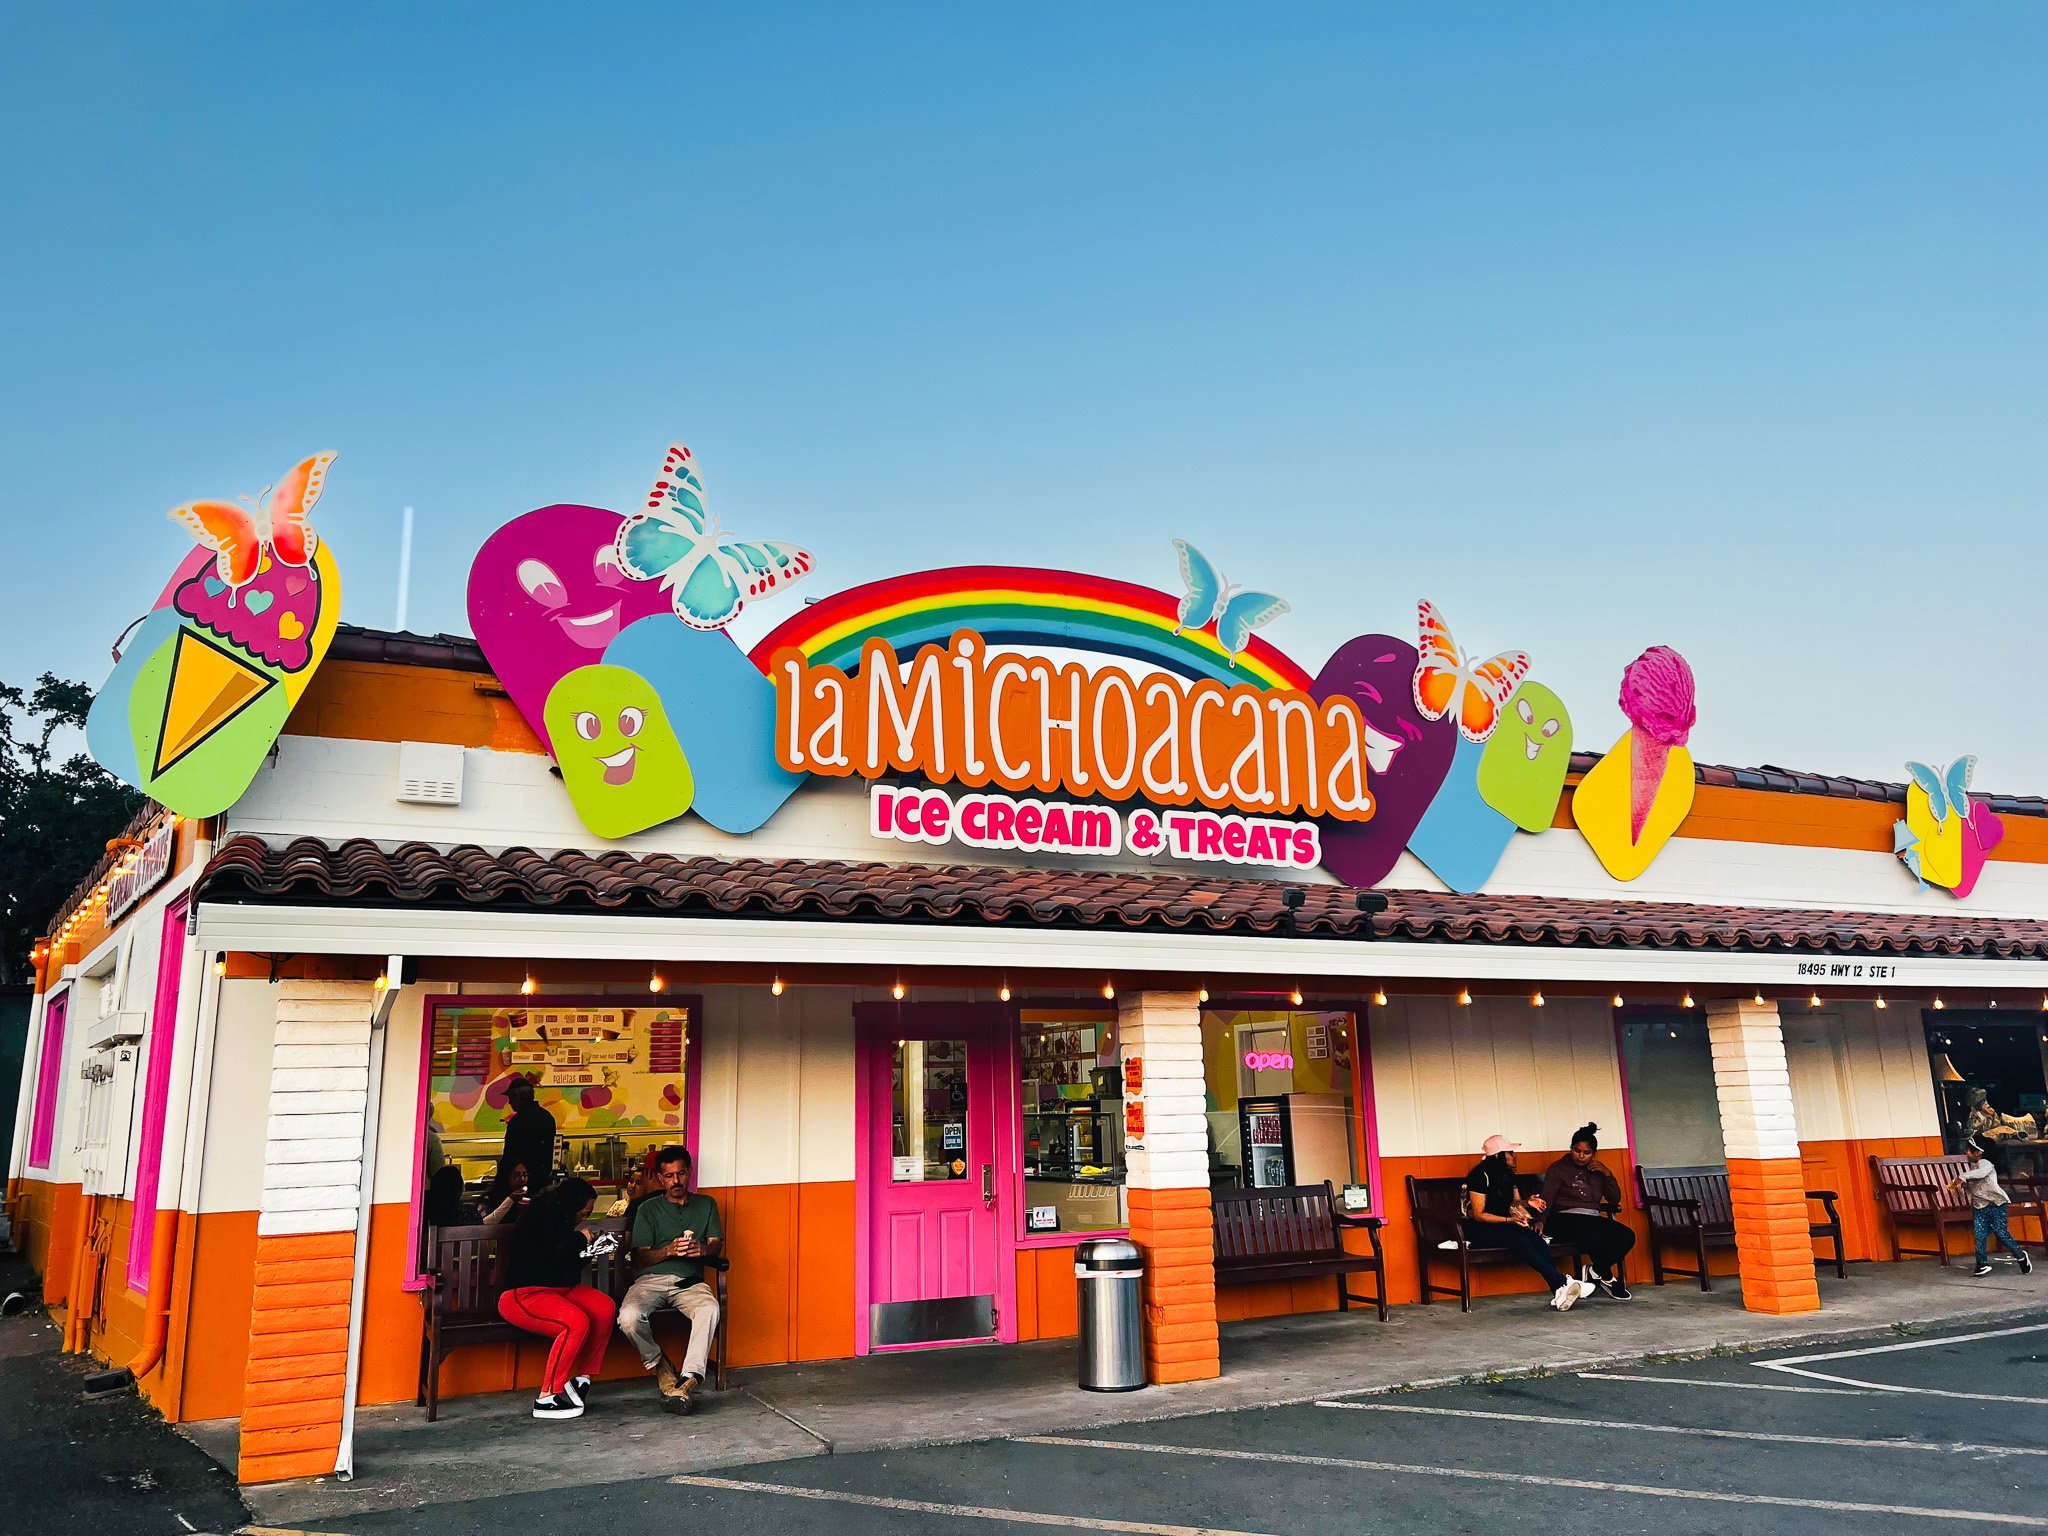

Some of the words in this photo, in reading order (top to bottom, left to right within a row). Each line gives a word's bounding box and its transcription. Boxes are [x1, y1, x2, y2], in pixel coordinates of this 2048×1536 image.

[1132, 814, 1161, 849] &
[1797, 963, 1826, 976] 18495
[1830, 964, 1851, 977] HWY
[1853, 965, 1863, 977] 12
[1869, 966, 1888, 978] STE
[1891, 966, 1896, 978] 1
[1244, 1052, 1294, 1073] open
[945, 1127, 962, 1136] OPEN
